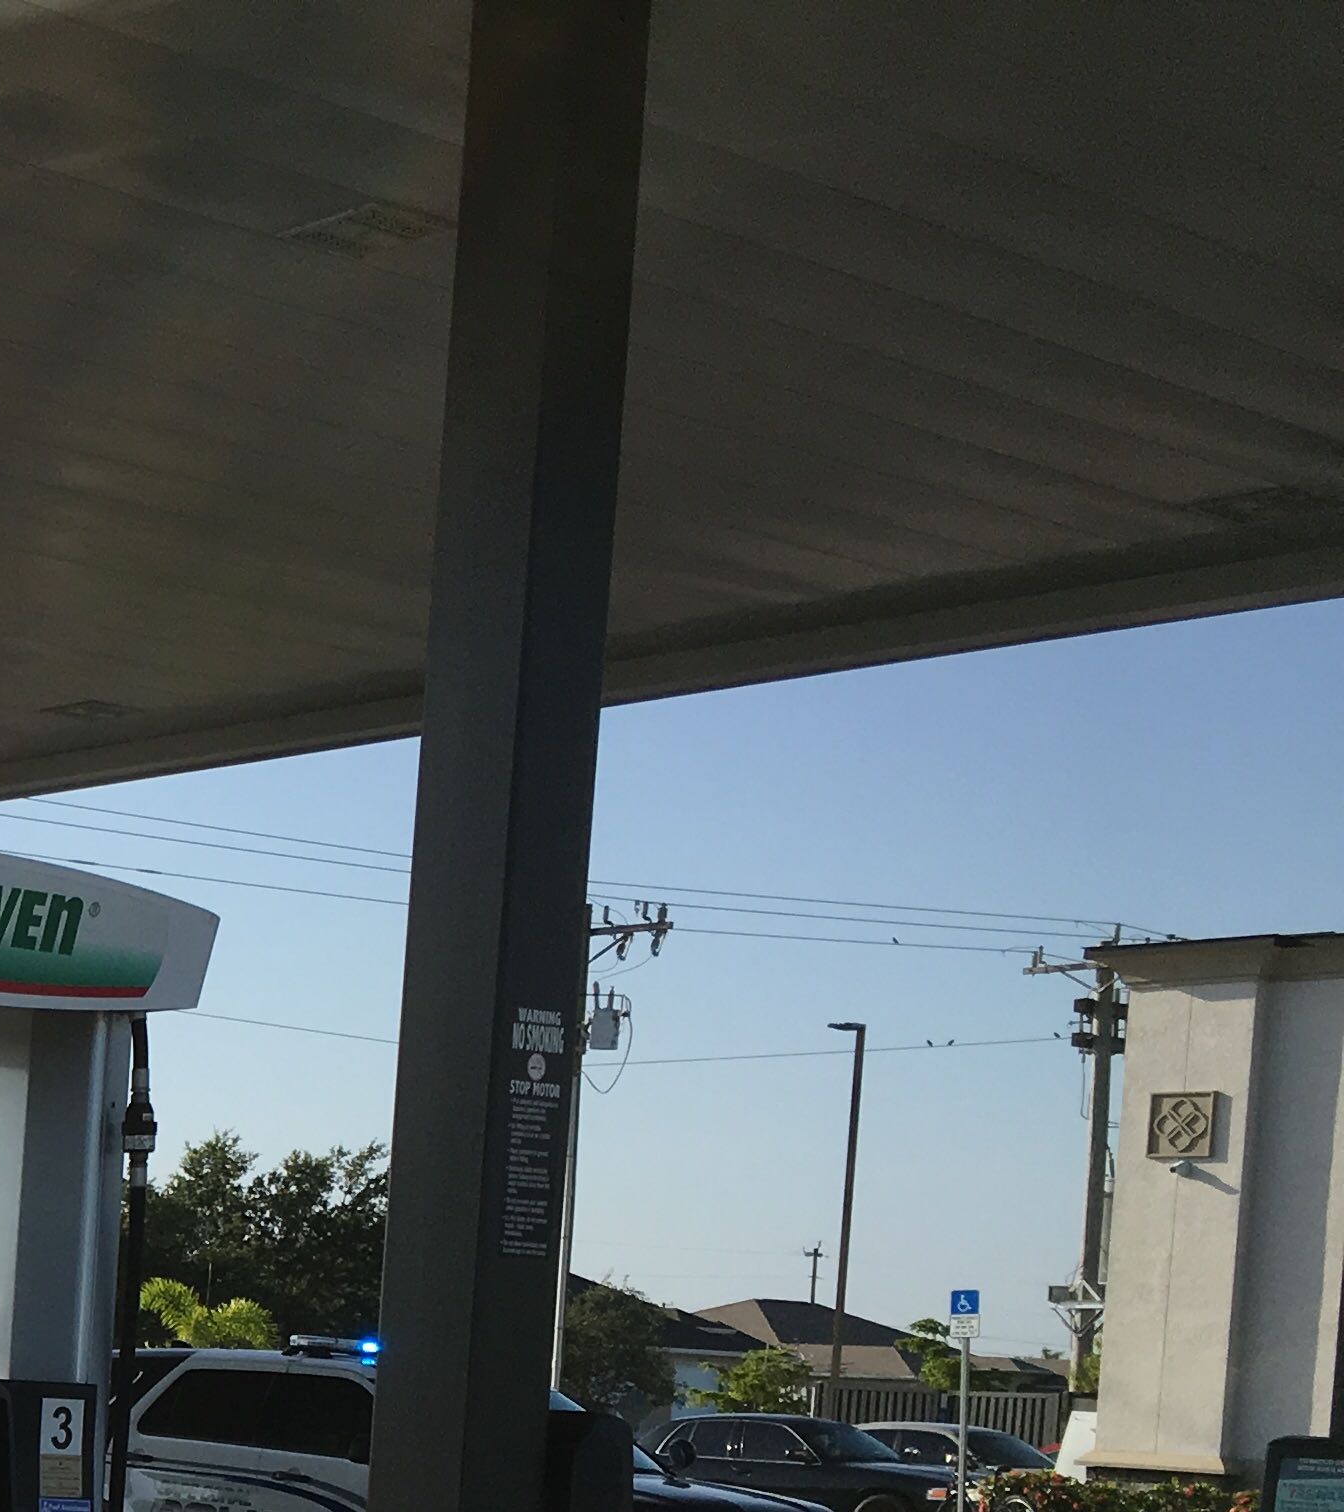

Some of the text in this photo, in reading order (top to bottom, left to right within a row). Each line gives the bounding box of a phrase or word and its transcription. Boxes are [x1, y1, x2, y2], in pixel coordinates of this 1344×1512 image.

[518, 1007, 562, 1025] WARNING
[512, 1023, 564, 1054] NO SMOKING
[510, 1080, 561, 1099] STOP MOTOR
[51, 1406, 73, 1450] 3
